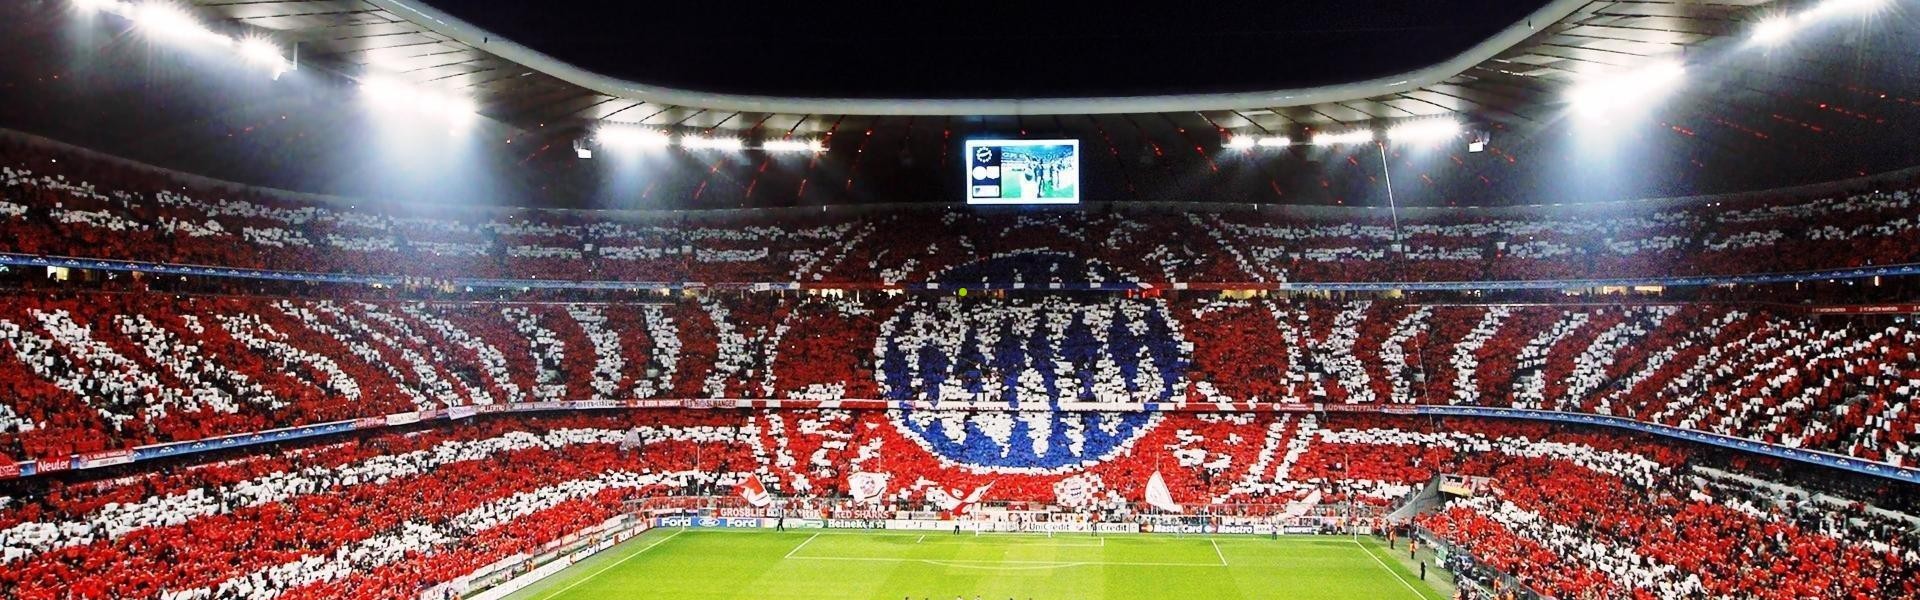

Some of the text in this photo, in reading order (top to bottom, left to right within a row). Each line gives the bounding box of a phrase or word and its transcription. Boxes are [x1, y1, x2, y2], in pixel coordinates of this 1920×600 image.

[854, 509, 890, 519] SHARKS
[661, 517, 692, 527] Ford
[726, 518, 757, 528] Ford
[1086, 523, 1127, 532] UiCredit
